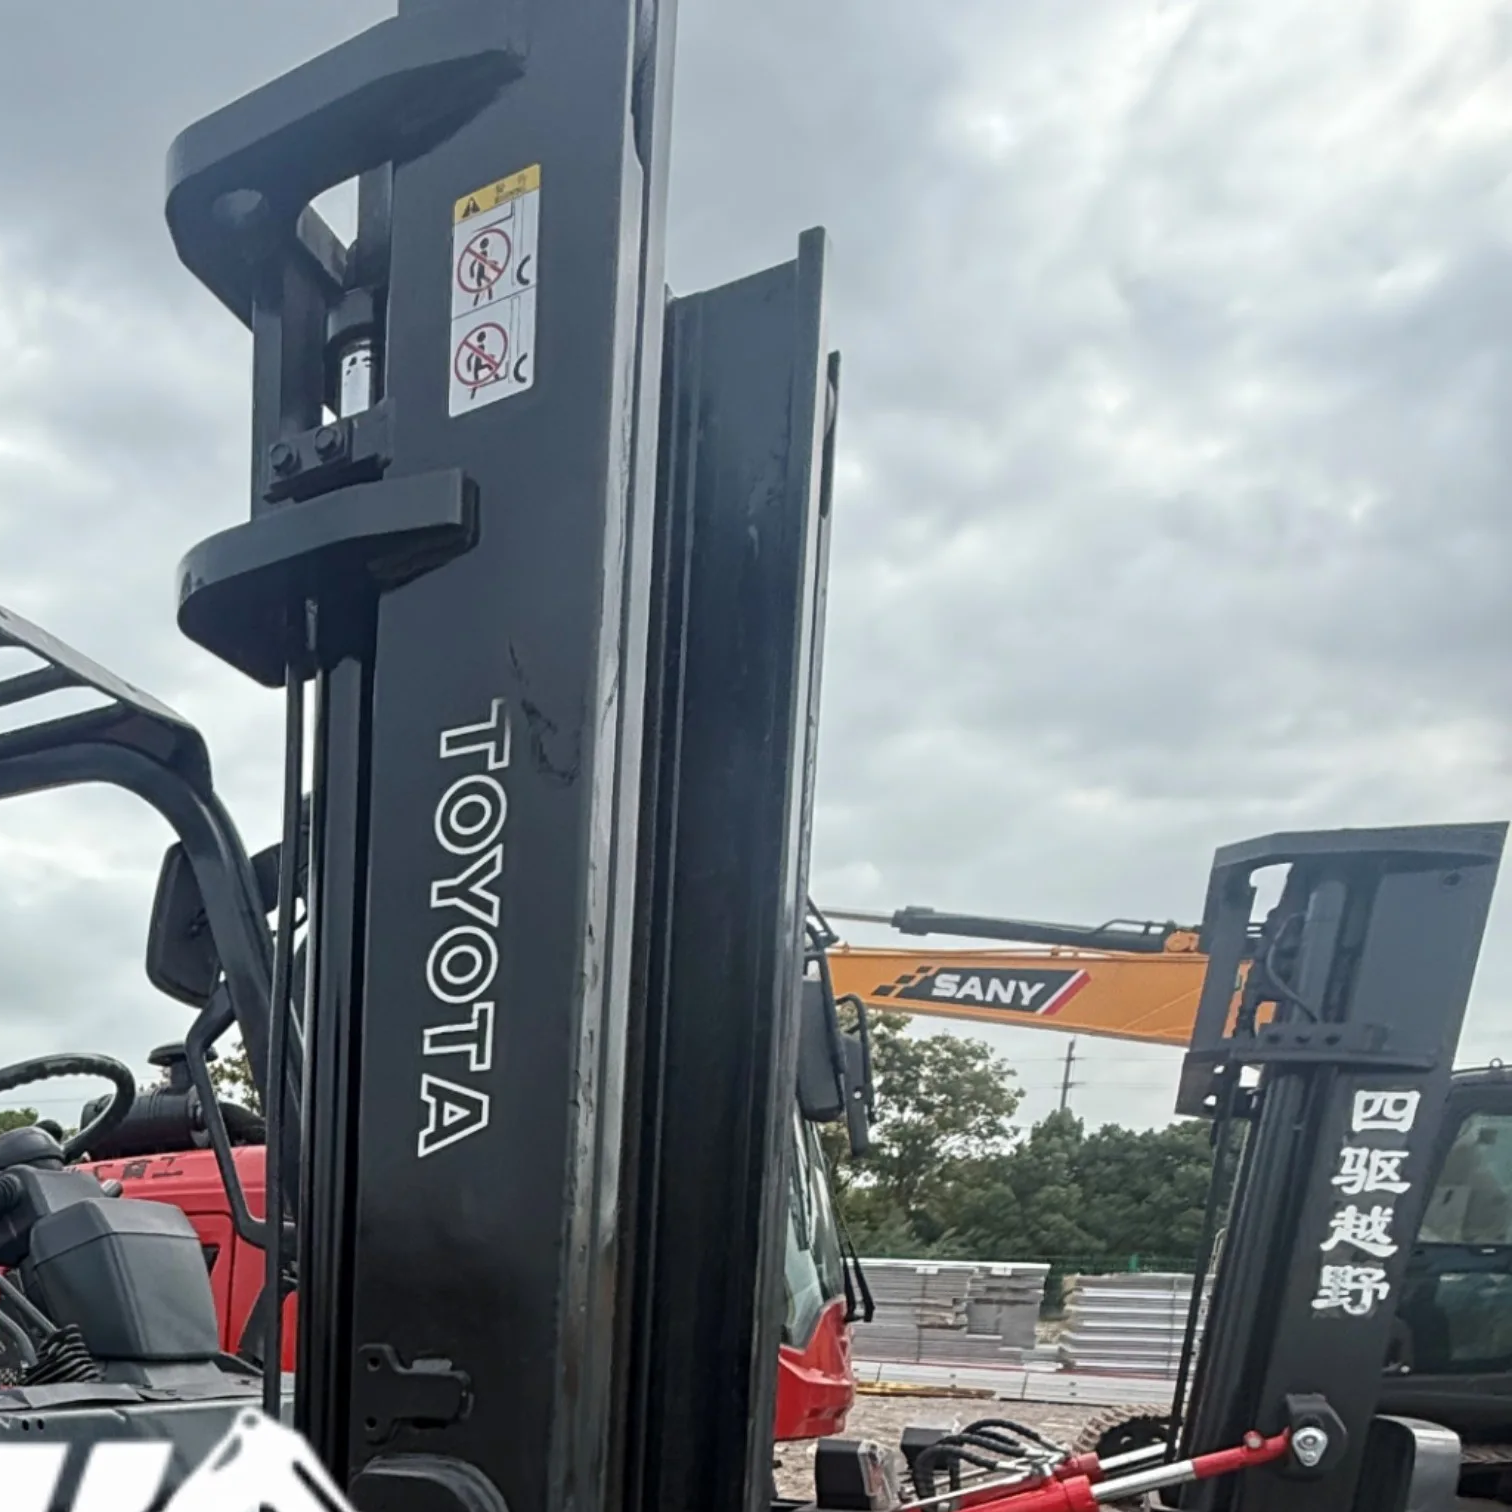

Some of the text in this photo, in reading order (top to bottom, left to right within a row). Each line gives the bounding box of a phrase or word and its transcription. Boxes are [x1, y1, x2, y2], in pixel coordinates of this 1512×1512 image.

[417, 697, 511, 1158] TOYOTA
[931, 973, 1045, 1006] SANY
[1311, 1089, 1421, 1316] 四驱越野
